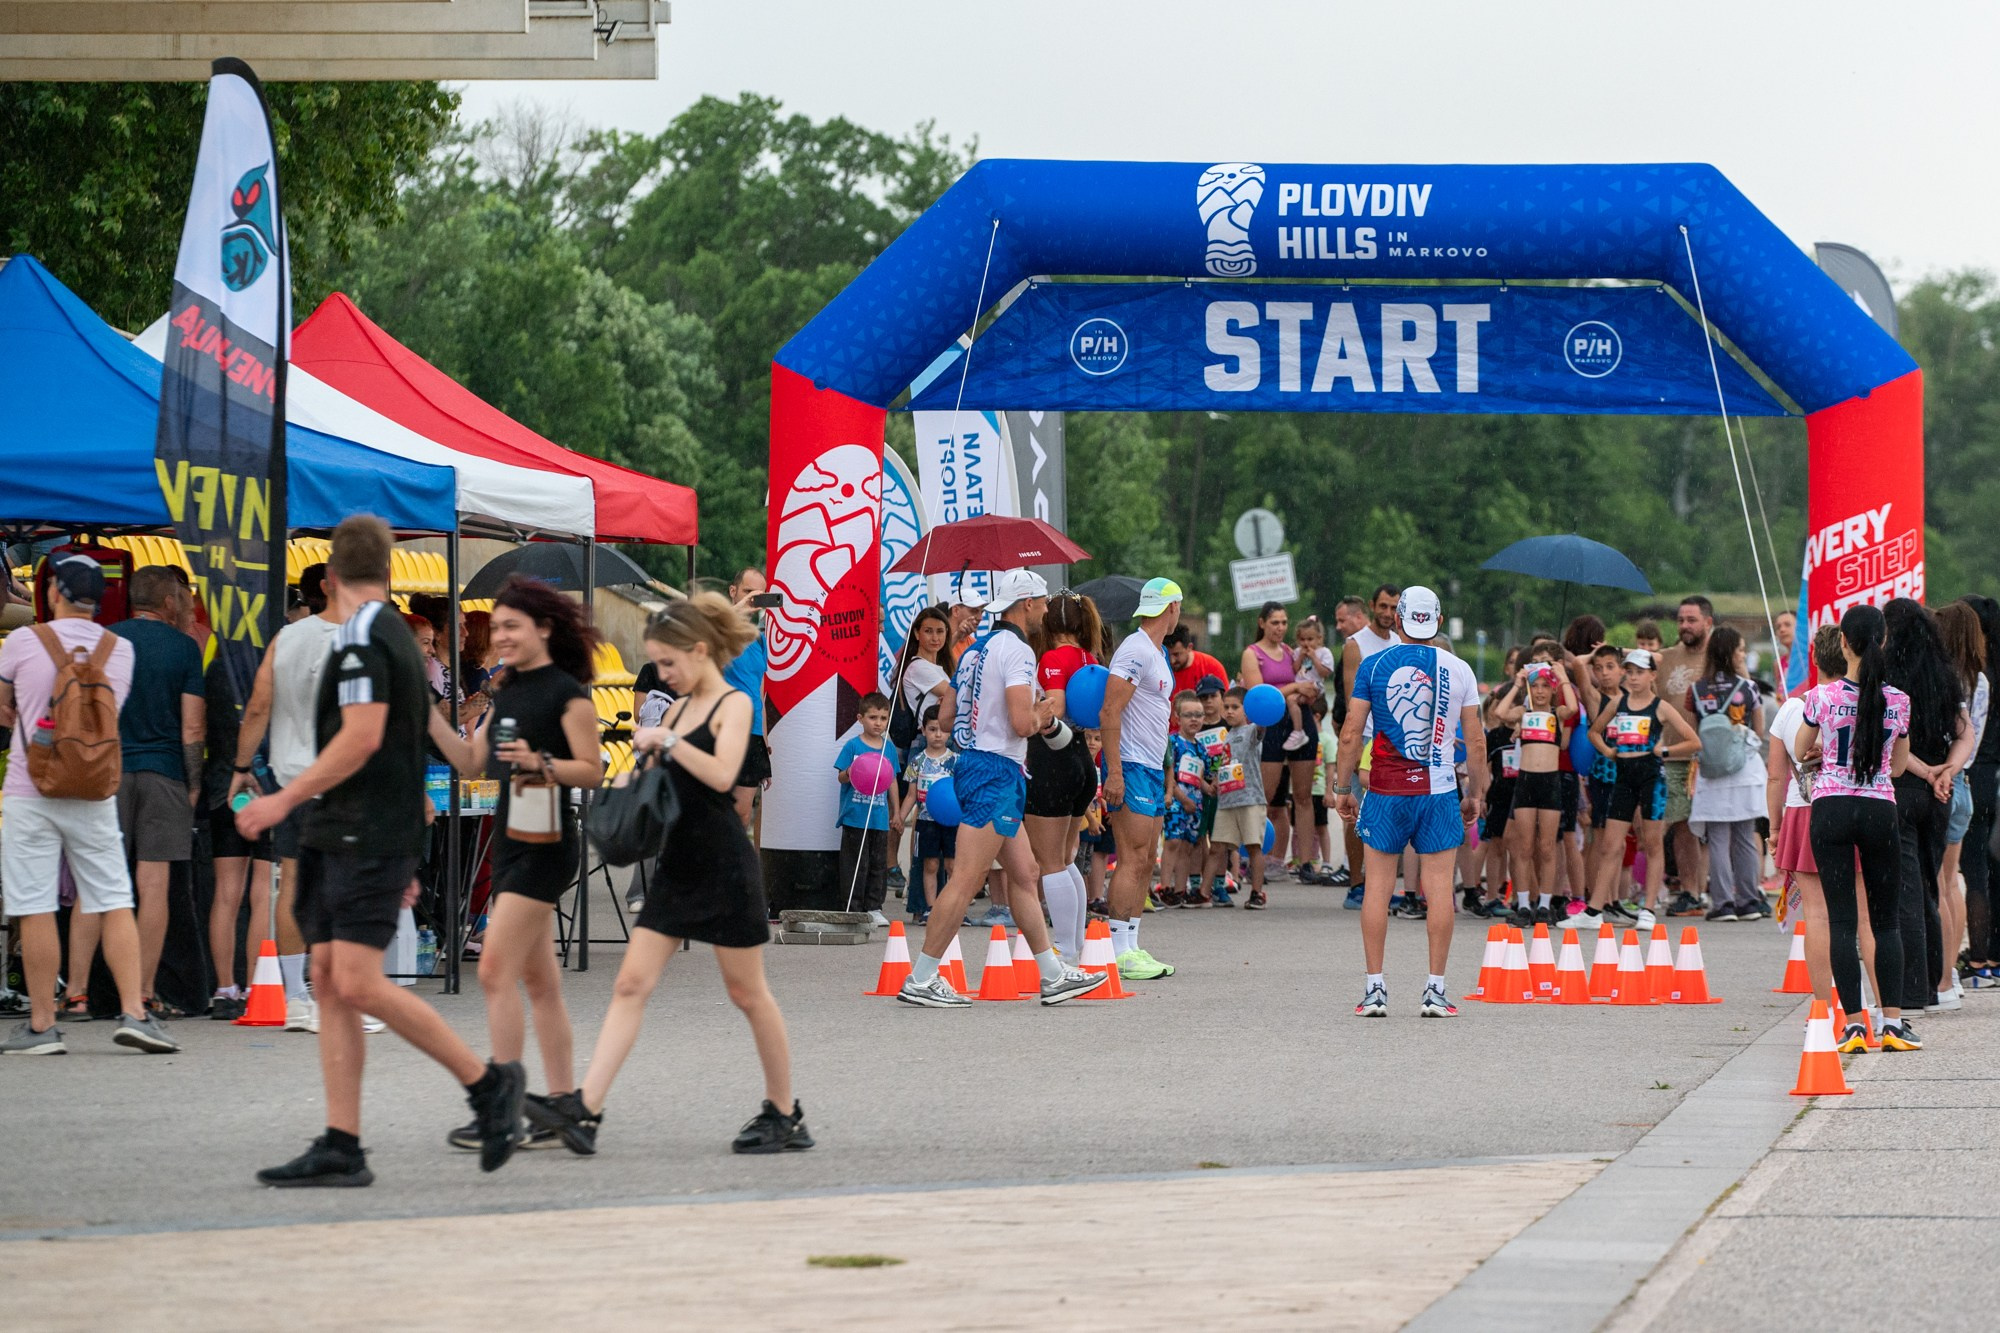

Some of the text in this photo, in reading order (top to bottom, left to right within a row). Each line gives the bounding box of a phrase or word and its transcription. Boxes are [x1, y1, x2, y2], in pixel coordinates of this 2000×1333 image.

[1278, 183, 1433, 217] PLOVDIV
[1278, 227, 1377, 260] HILLS
[1388, 232, 1408, 242] IN
[1388, 247, 1488, 258] MARKOVO
[1080, 336, 1118, 355] P/H
[1203, 301, 1491, 393] START
[1574, 338, 1612, 357] P/H
[1835, 528, 1918, 596] STEP
[820, 607, 865, 627] PLOVDIV
[831, 624, 861, 640] HILLS
[1437, 666, 1450, 718] MATTERS
[1433, 716, 1446, 746] STEP
[1527, 717, 1540, 727] 61
[1620, 721, 1632, 731] 62
[1200, 734, 1217, 745] 105
[1187, 762, 1199, 775] 21
[1219, 771, 1230, 782] 60
